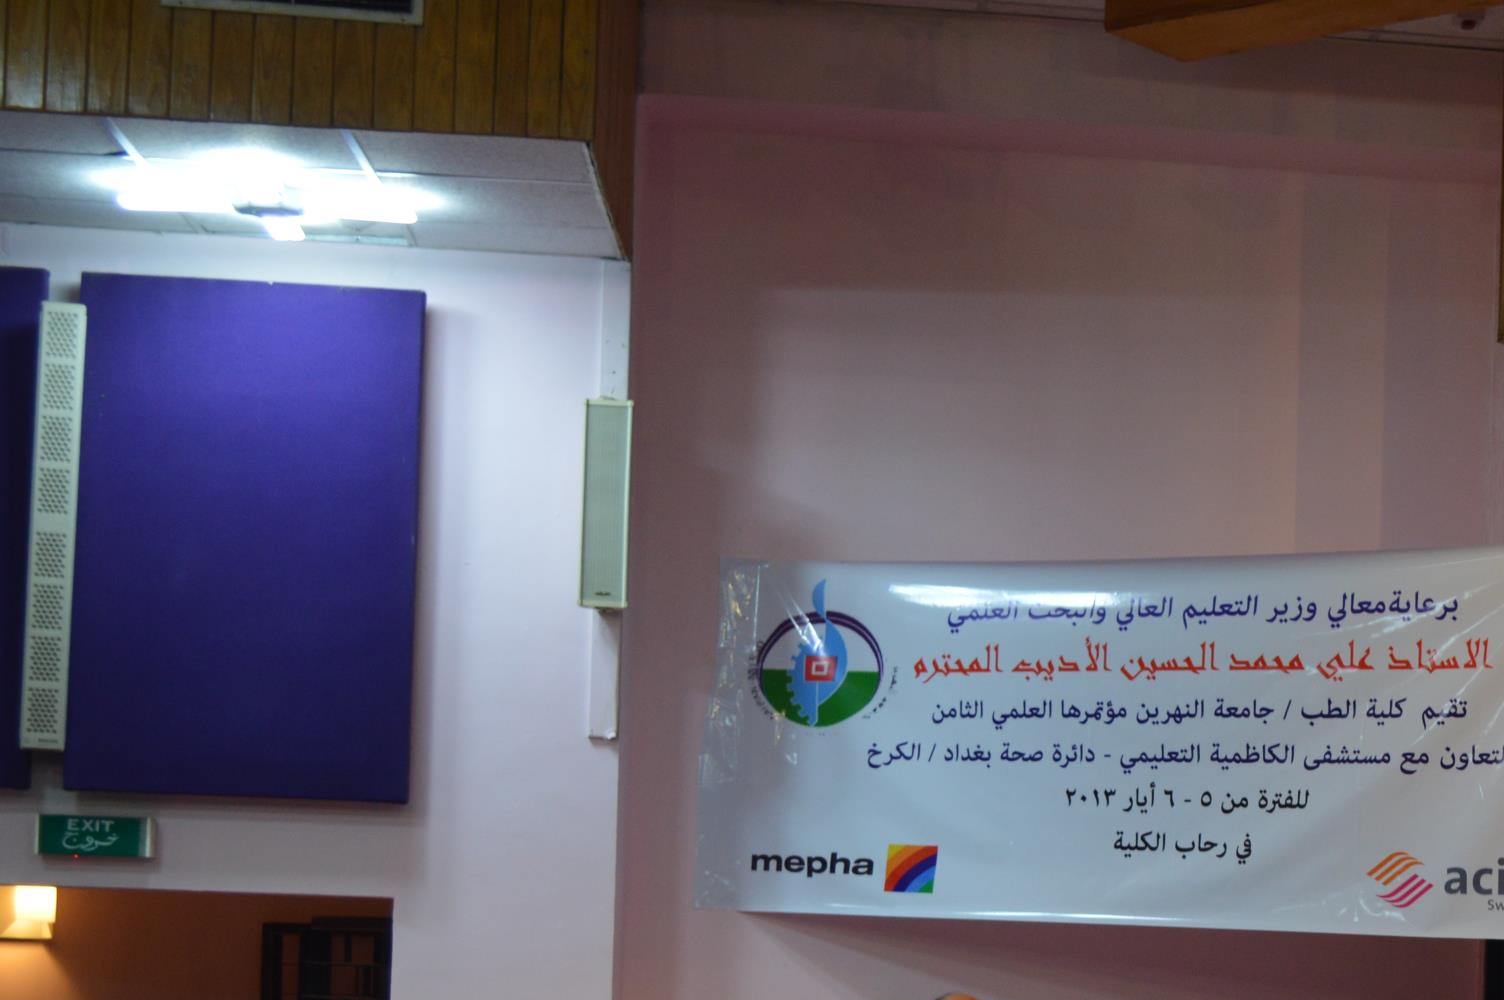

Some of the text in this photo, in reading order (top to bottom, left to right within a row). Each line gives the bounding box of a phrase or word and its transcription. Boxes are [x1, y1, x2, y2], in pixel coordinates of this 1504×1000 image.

[1116, 596, 1174, 632] العالي
[1182, 593, 1259, 631] التعليم
[1267, 599, 1317, 624] وزير
[913, 643, 1004, 684] المحترم
[1011, 636, 1112, 681] الأديب
[1119, 640, 1219, 682] الحسين
[1229, 655, 1305, 674] محمد
[1316, 639, 1374, 682] علي
[932, 700, 984, 725] الثامن
[991, 700, 1052, 731] العلمي
[1060, 700, 1128, 727] مؤتمرها
[1135, 698, 1205, 728] النهرين
[1214, 700, 1275, 727] جامعة
[1300, 699, 1357, 729] الطب
[1366, 697, 1406, 719] كلية
[1421, 699, 1468, 730] تقيم
[866, 741, 921, 769] الكرخ
[944, 744, 992, 769] بغداد
[999, 742, 1044, 764] صحة
[1052, 743, 1096, 770] دائرة
[1119, 744, 1201, 775] التعليمي
[1209, 744, 1296, 771] الكاظمية
[1303, 745, 1391, 772] مستشفى
[1399, 749, 1430, 775] مع
[1065, 787, 1117, 809] ٢٠١٣
[1123, 781, 1156, 814] أيار
[1163, 788, 1175, 809] ٦
[1220, 791, 1249, 814] من
[1257, 788, 1311, 813] للفترة
[66, 818, 115, 832] EXIT
[1113, 830, 1253, 865] في رحاب الكلية
[750, 852, 875, 878] mepha
